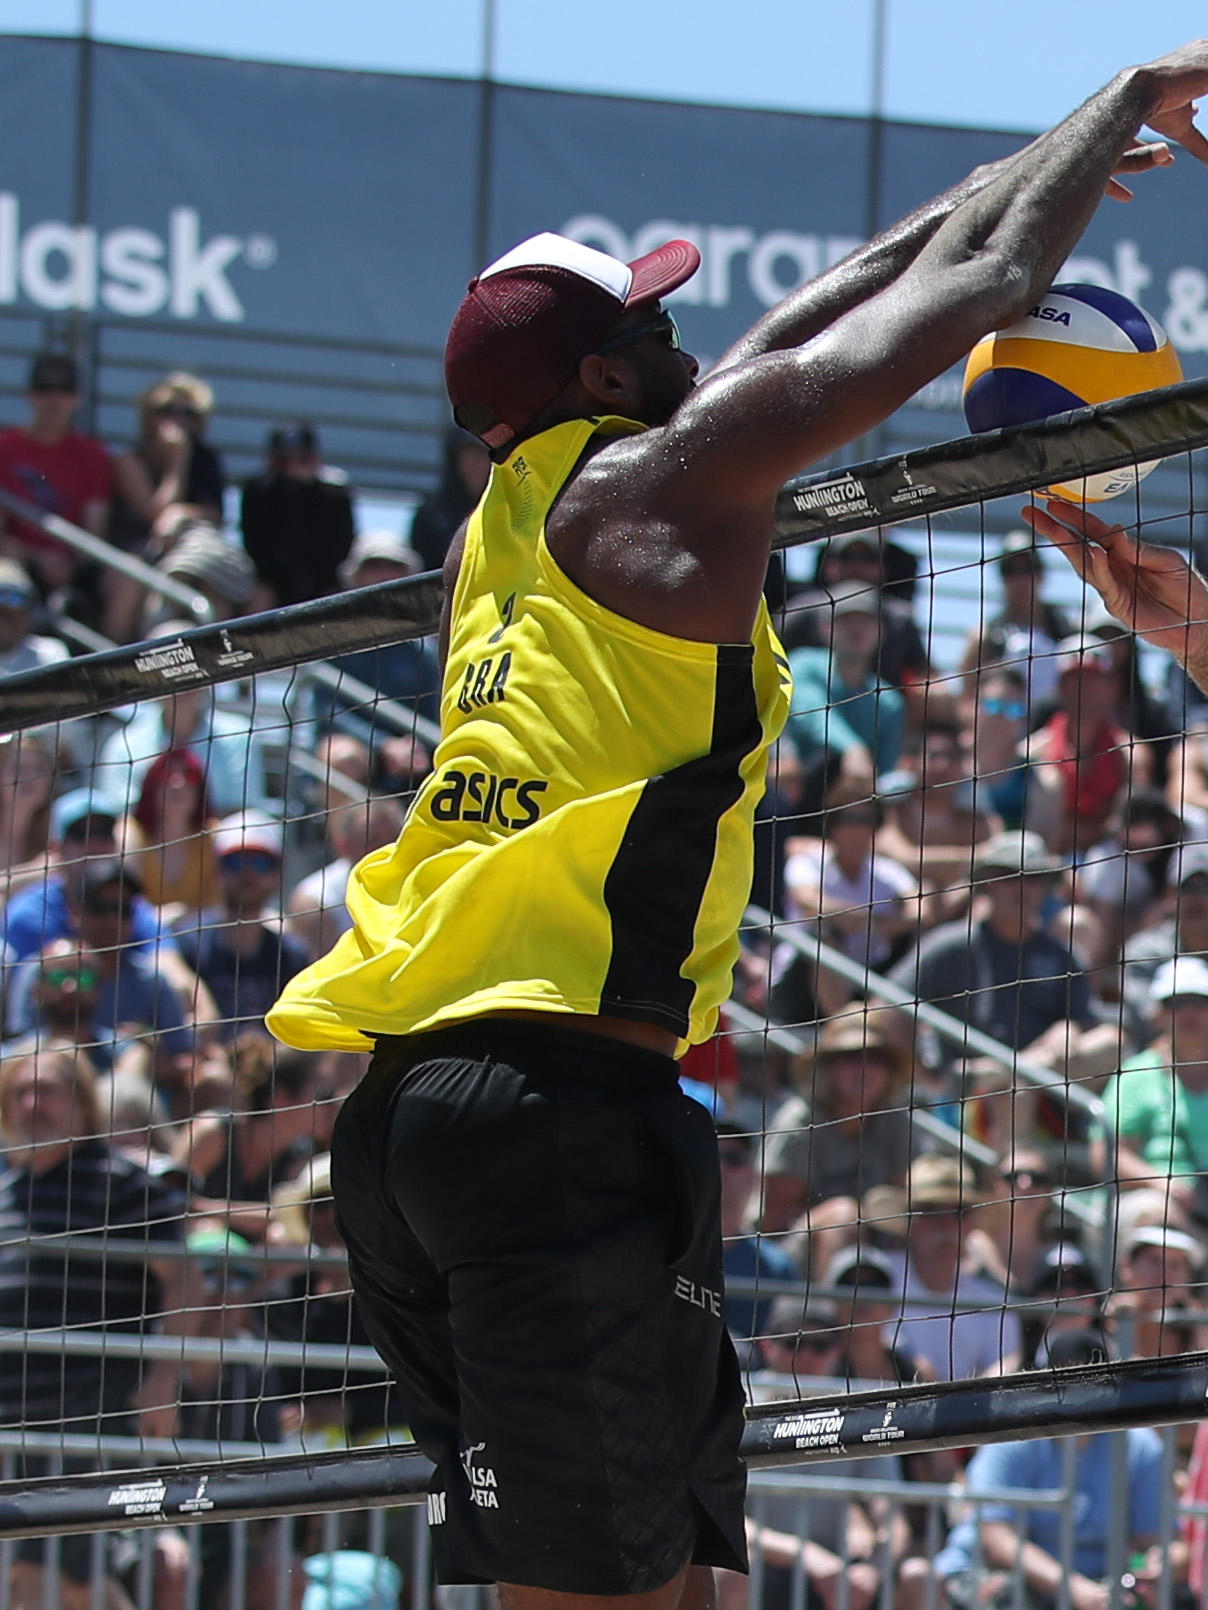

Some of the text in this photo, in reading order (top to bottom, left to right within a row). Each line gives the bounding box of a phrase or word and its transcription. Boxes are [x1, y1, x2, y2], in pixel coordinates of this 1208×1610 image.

[793, 478, 866, 511] HUNTINGTON
[825, 502, 850, 517] BEACH
[849, 498, 869, 513] OPEN
[134, 645, 195, 673] HUNTINGTON
[430, 770, 549, 830] asics
[673, 1274, 721, 1318] ELITE
[774, 1414, 845, 1439] HUNTINGTON
[795, 1433, 840, 1449] BEACH OPEN
